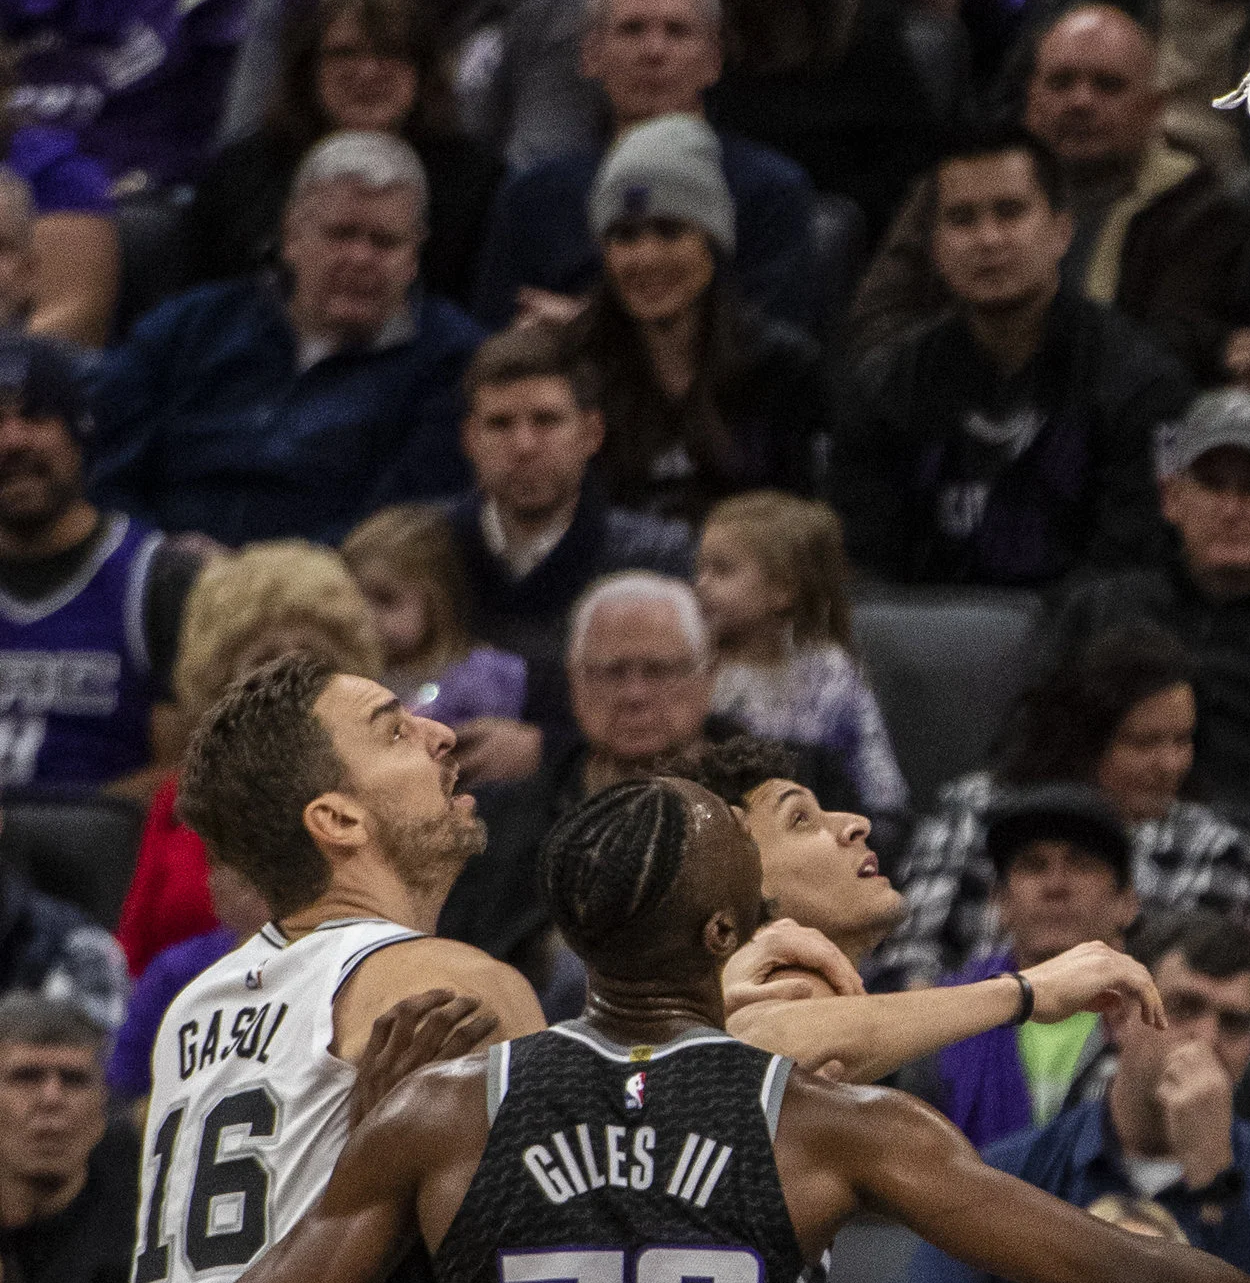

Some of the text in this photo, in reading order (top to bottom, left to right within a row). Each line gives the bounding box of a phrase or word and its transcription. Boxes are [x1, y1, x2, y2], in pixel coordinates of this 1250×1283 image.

[178, 1002, 288, 1081] GASOL
[523, 1123, 733, 1208] GILES III
